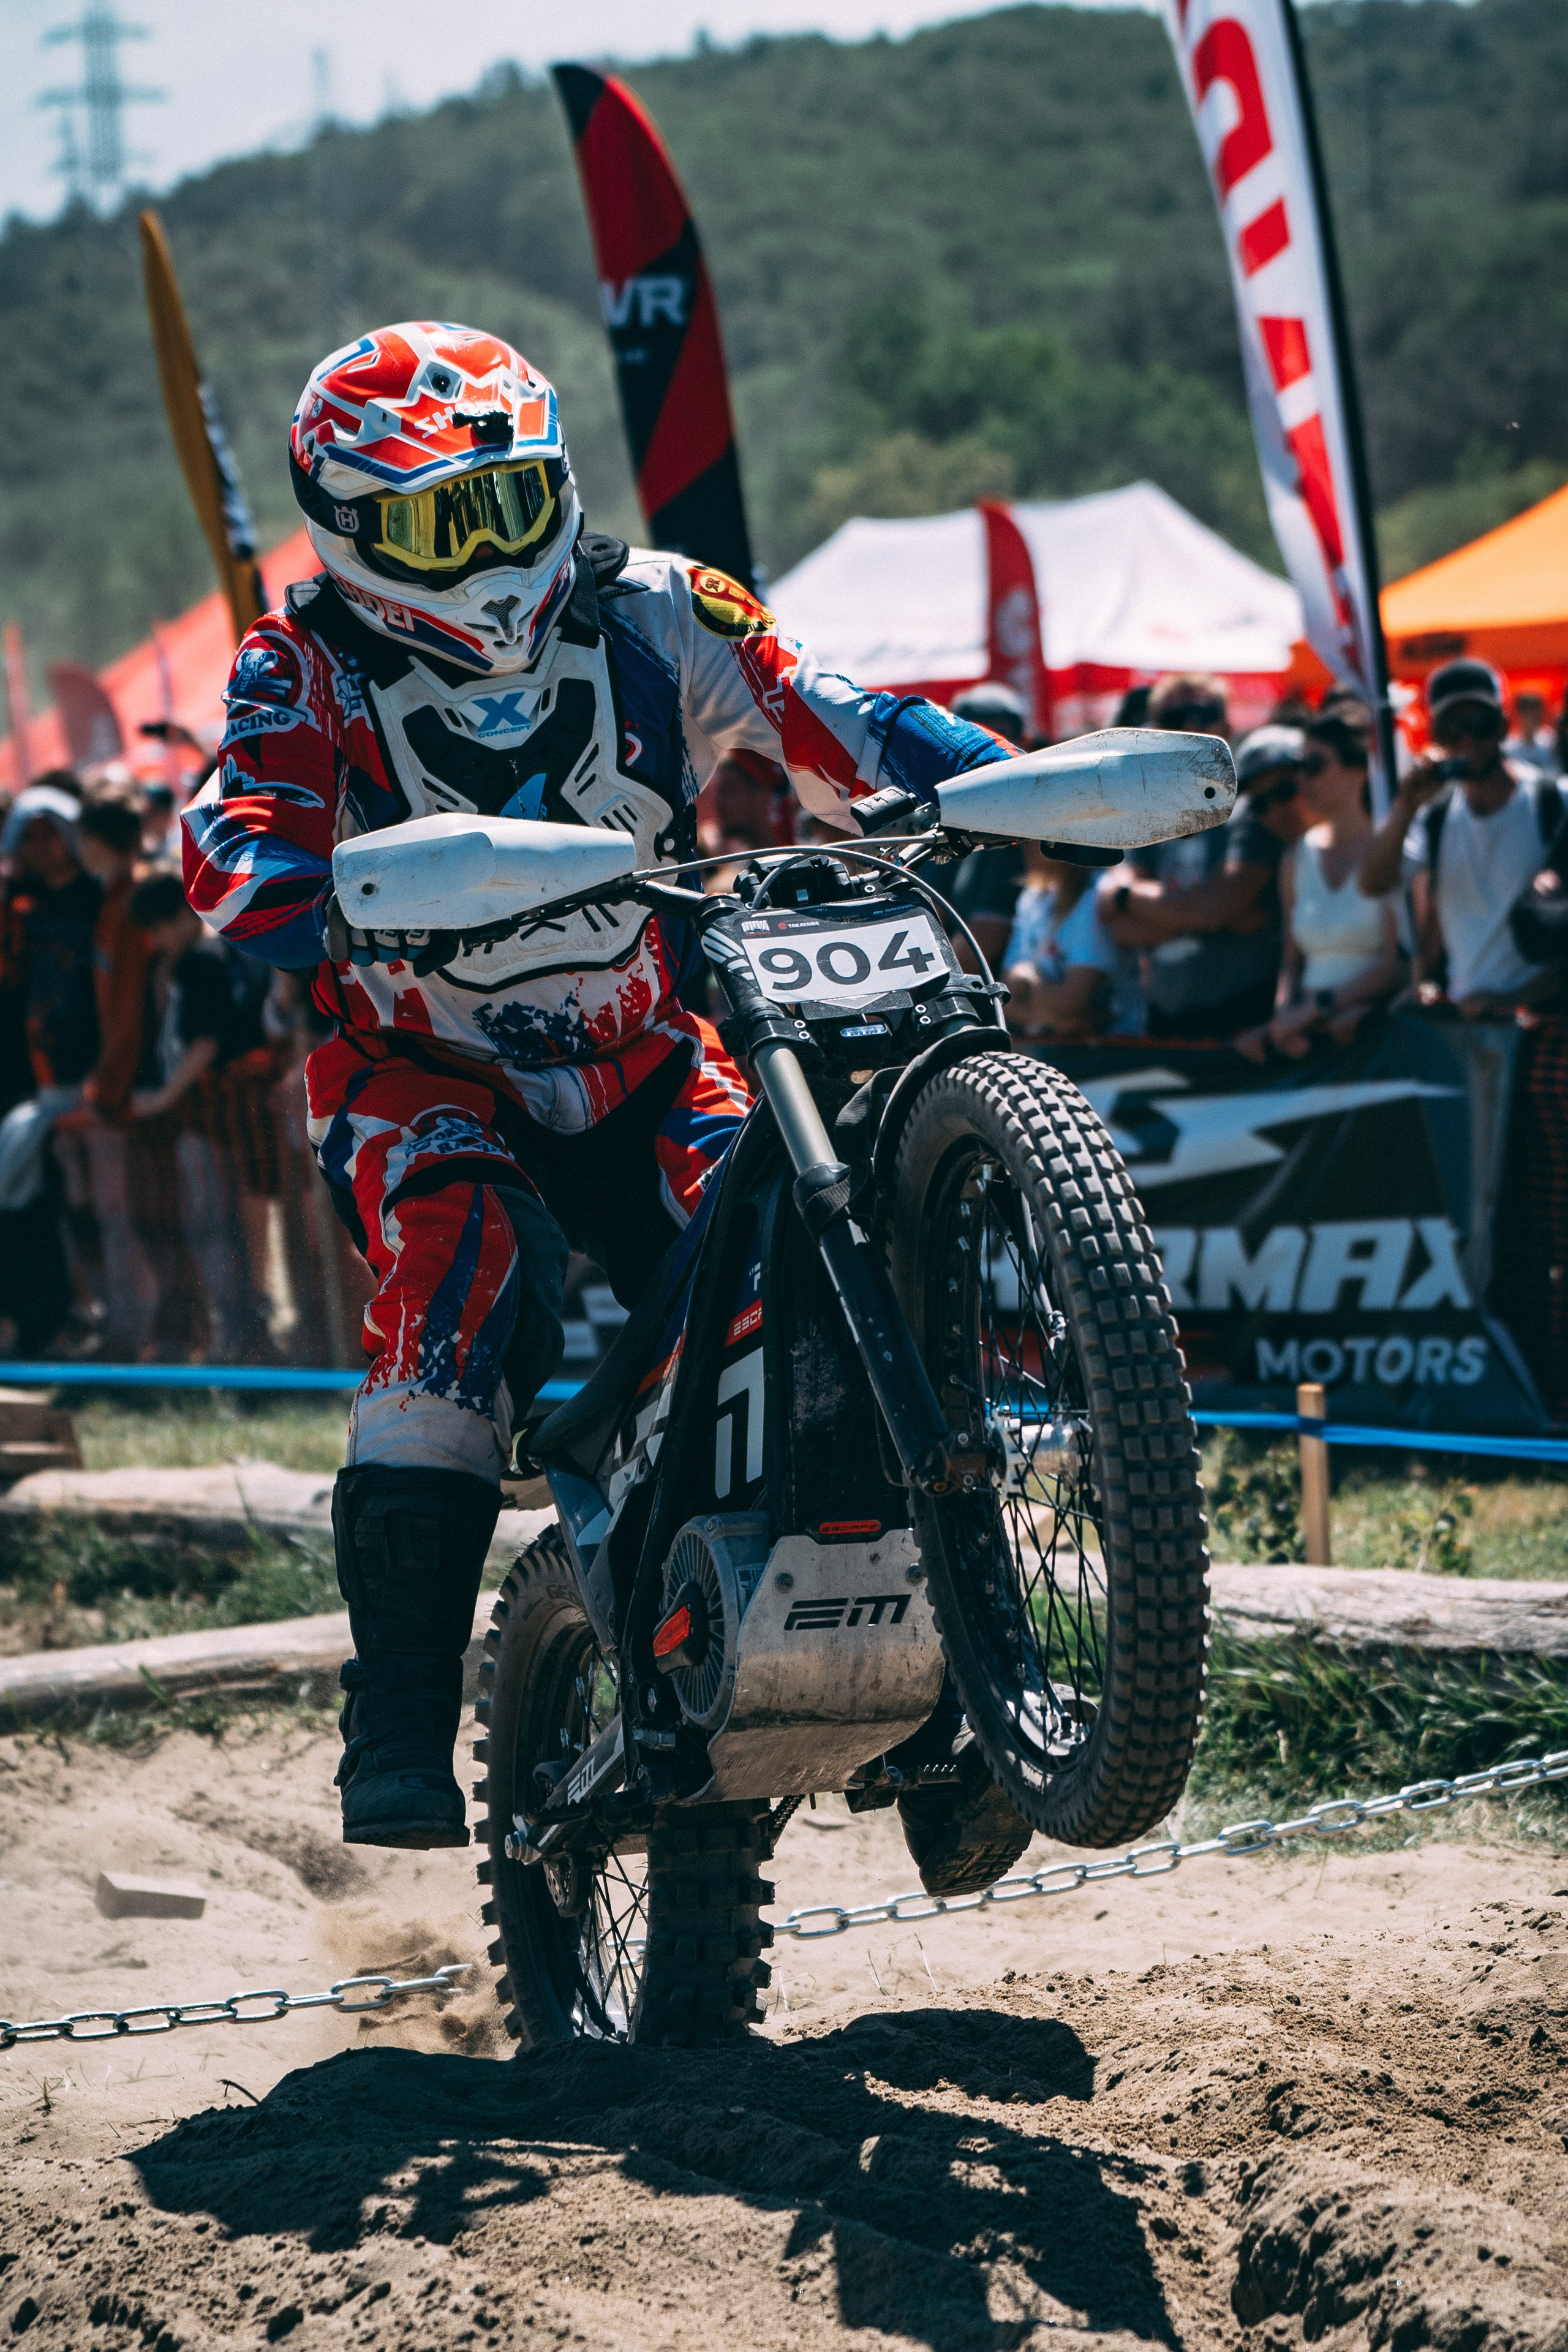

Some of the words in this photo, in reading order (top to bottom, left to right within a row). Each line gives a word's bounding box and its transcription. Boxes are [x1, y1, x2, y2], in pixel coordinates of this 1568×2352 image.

[470, 691, 532, 733] X
[478, 725, 532, 739] CONCEPT
[758, 930, 935, 990] 904
[1254, 1336, 1487, 1384] MOTORS
